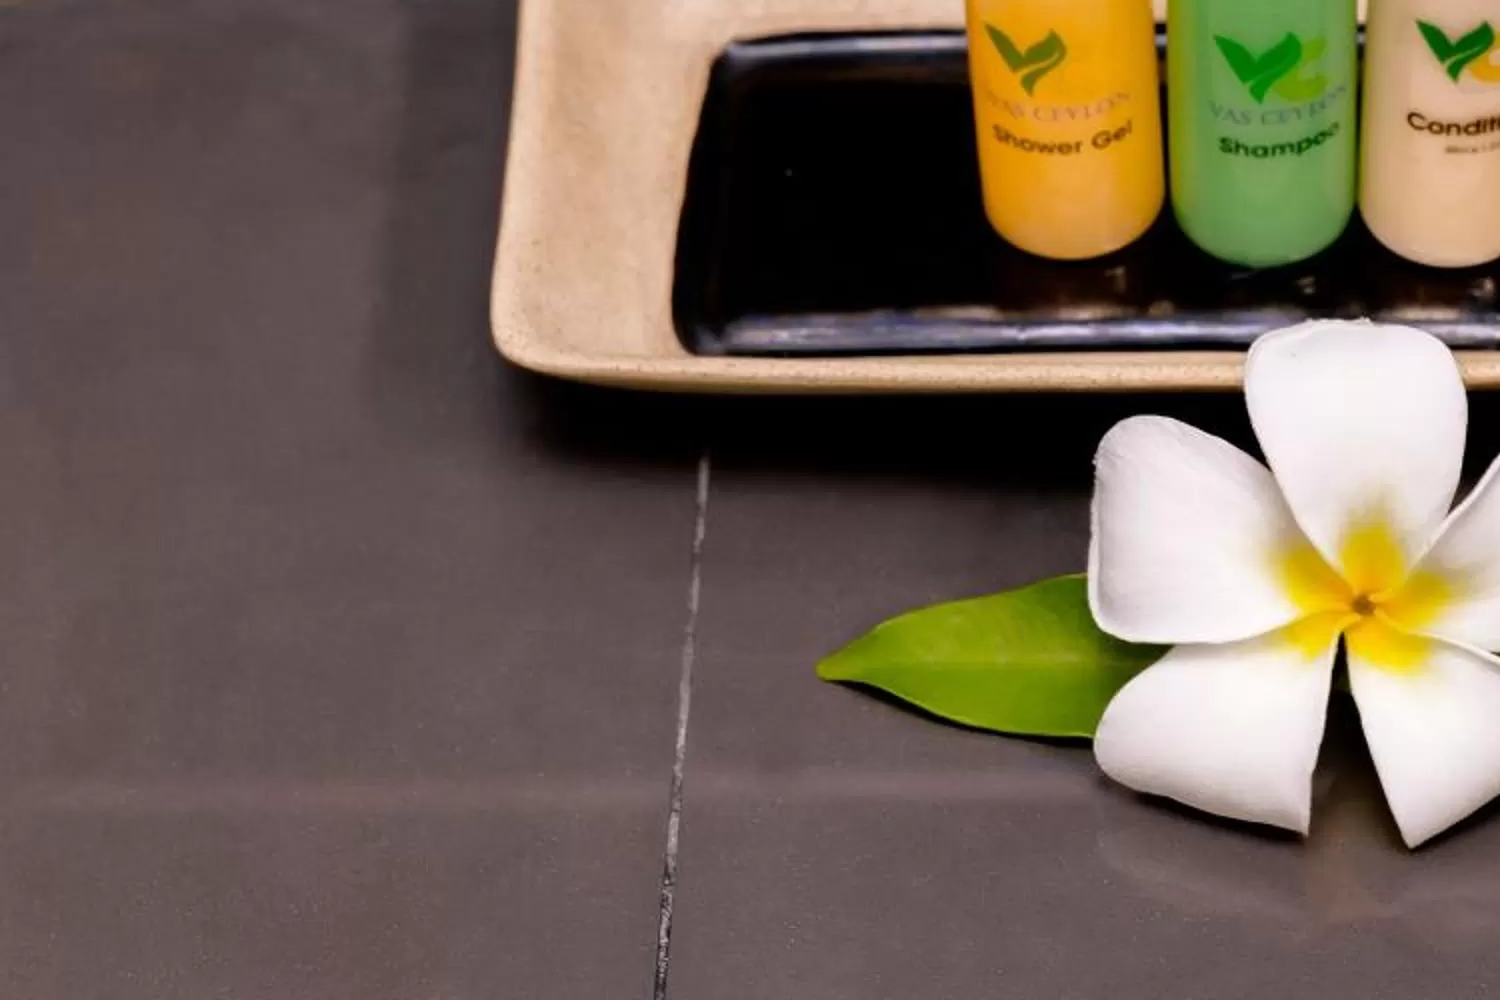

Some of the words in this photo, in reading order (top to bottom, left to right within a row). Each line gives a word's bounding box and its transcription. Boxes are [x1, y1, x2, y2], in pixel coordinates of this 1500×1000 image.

[992, 123, 1083, 156] Shower
[1091, 118, 1133, 150] Gel
[1218, 121, 1340, 159] Shampoo
